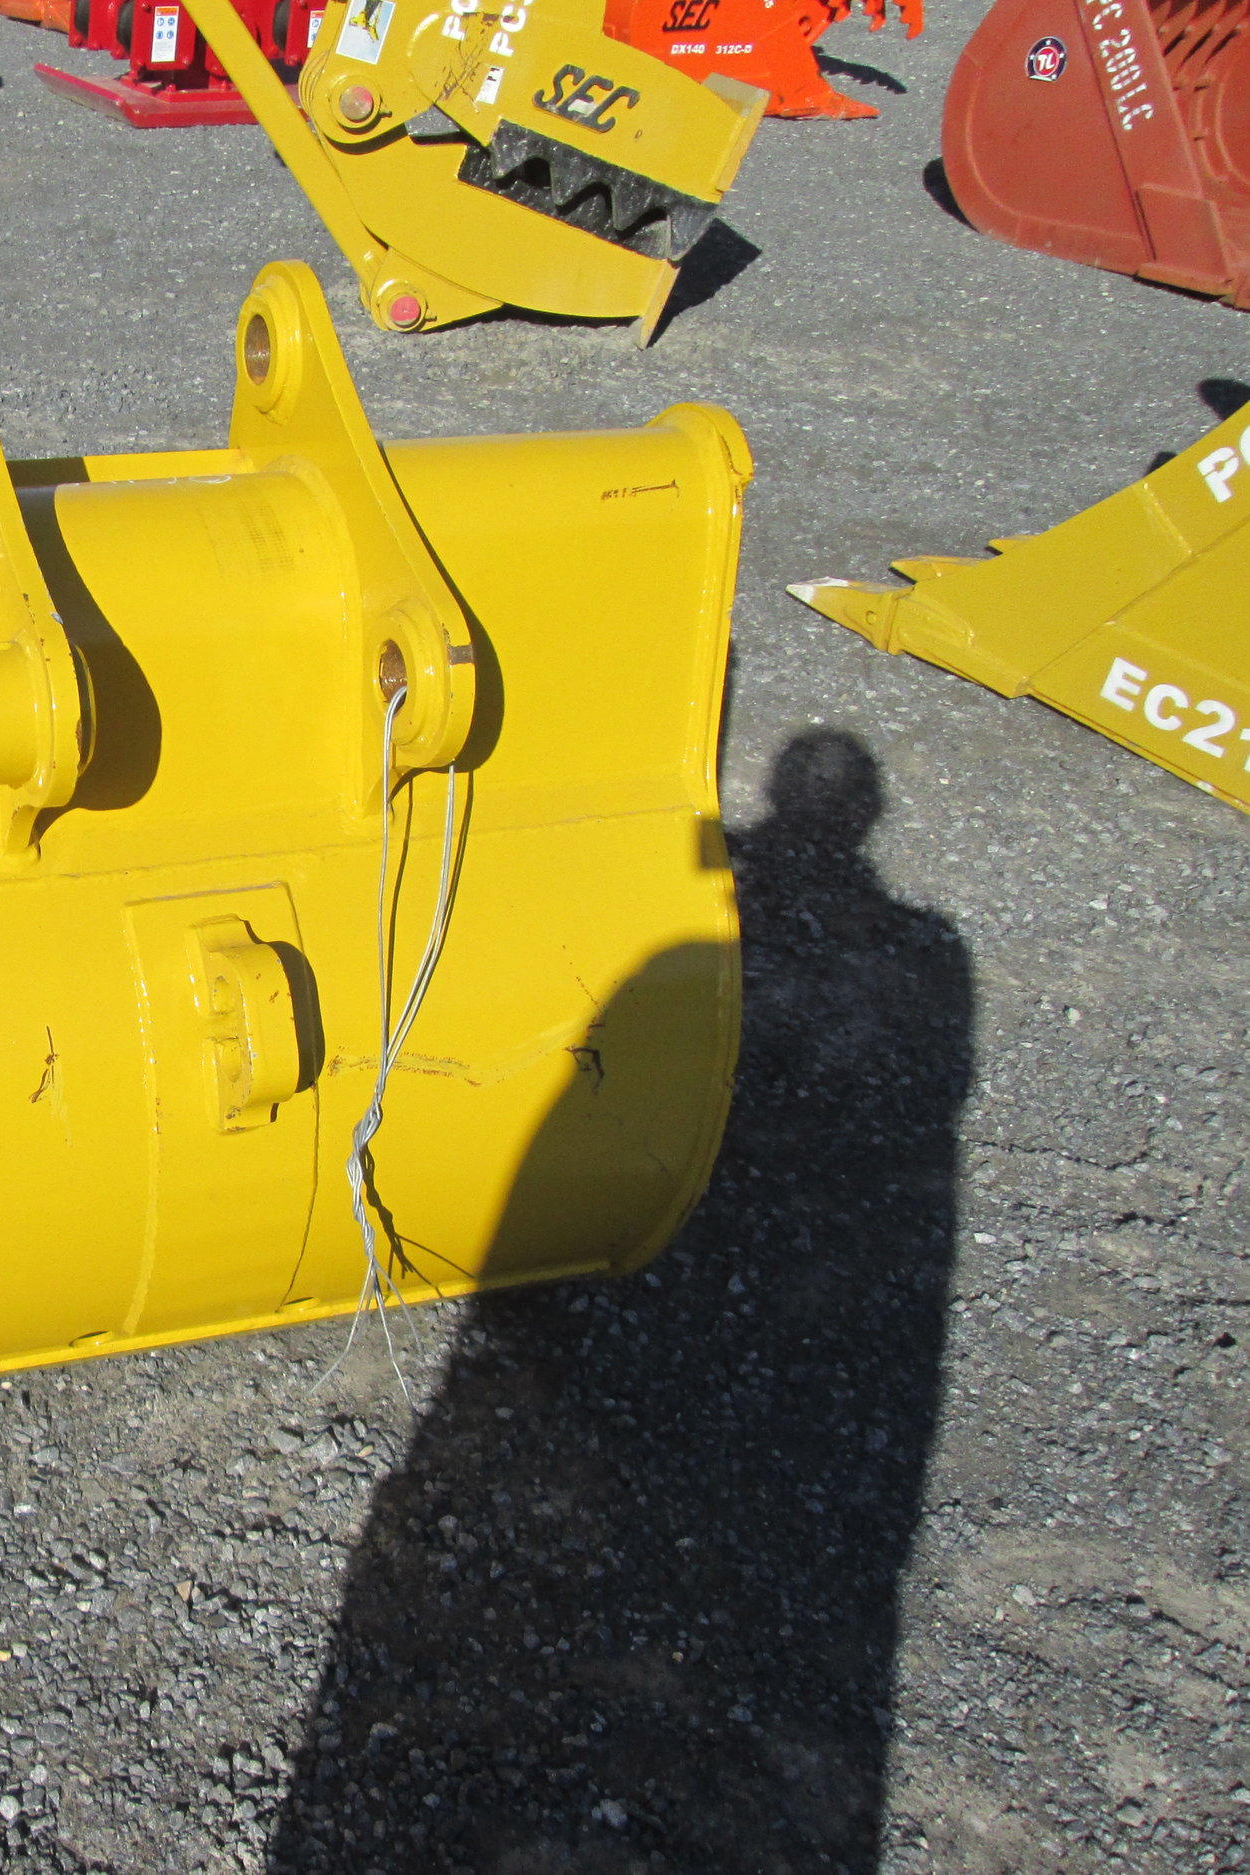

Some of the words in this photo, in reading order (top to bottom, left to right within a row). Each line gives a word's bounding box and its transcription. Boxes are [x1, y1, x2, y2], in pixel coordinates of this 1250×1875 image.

[488, 0, 535, 58] PC
[662, 0, 721, 33] SEC
[1085, 0, 1125, 30] C
[670, 44, 706, 55] DX140
[1037, 52, 1056, 72] TL
[532, 63, 641, 134] SEC
[1098, 27, 1155, 131] 200LC
[1196, 424, 1250, 503] P
